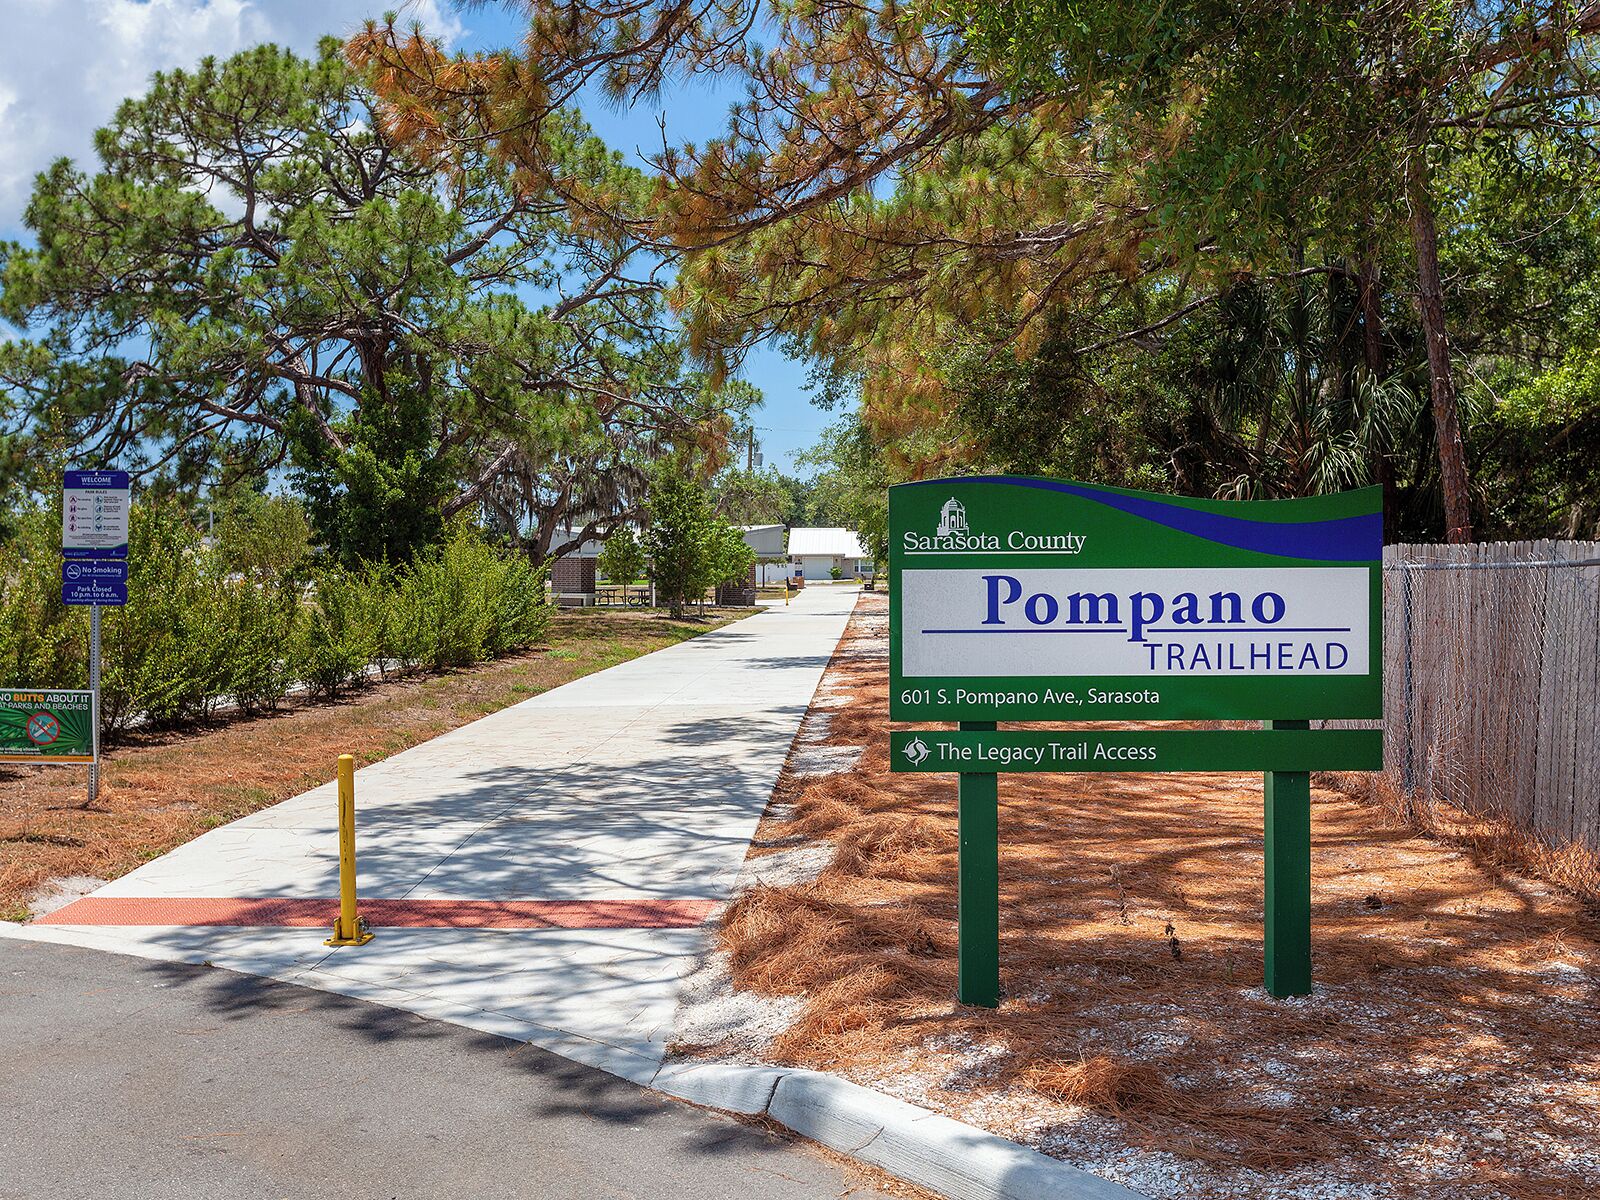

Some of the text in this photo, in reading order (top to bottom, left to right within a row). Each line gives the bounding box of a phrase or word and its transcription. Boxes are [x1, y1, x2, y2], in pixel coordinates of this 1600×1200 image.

[903, 531, 1087, 554] Sarasota County
[93, 566, 122, 574] Smoking
[981, 574, 1287, 642] Pompano
[1143, 642, 1349, 670] TRAILHEAD
[14, 693, 44, 702] BUTTS
[46, 694, 79, 703] ABOUT
[81, 694, 89, 703] IT
[901, 688, 1160, 708] 601 S. Pompano Ave., Sarasota
[936, 742, 1157, 764] The Legacy Trail Access
